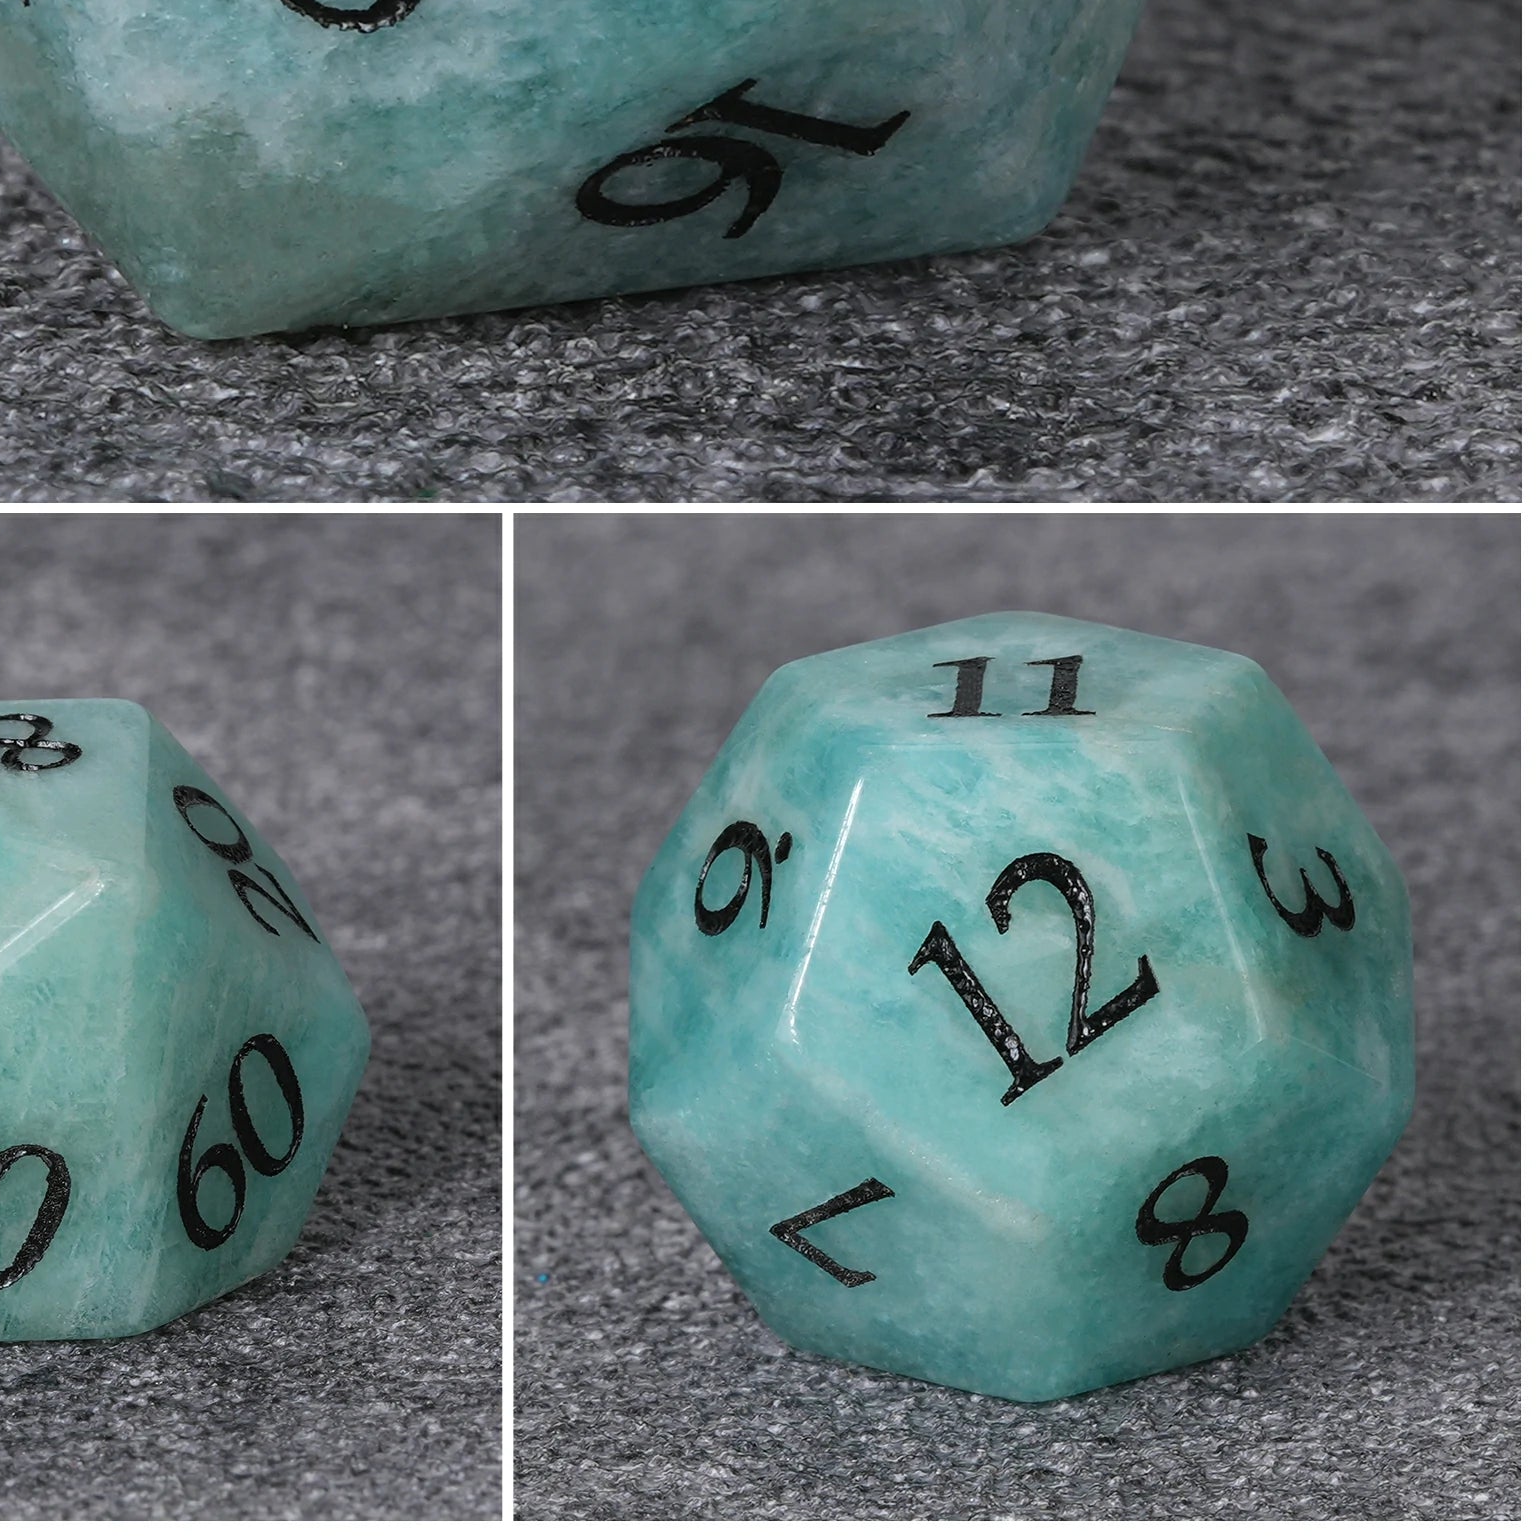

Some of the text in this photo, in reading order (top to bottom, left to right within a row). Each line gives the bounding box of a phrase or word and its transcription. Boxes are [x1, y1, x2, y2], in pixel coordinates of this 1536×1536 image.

[574, 79, 911, 240] 16
[928, 655, 1096, 718] 11
[1247, 833, 1355, 938] 3
[909, 854, 1160, 1105] 12
[176, 1035, 306, 1252] 60
[769, 1178, 895, 1288] 7
[1135, 1157, 1249, 1291] 8
